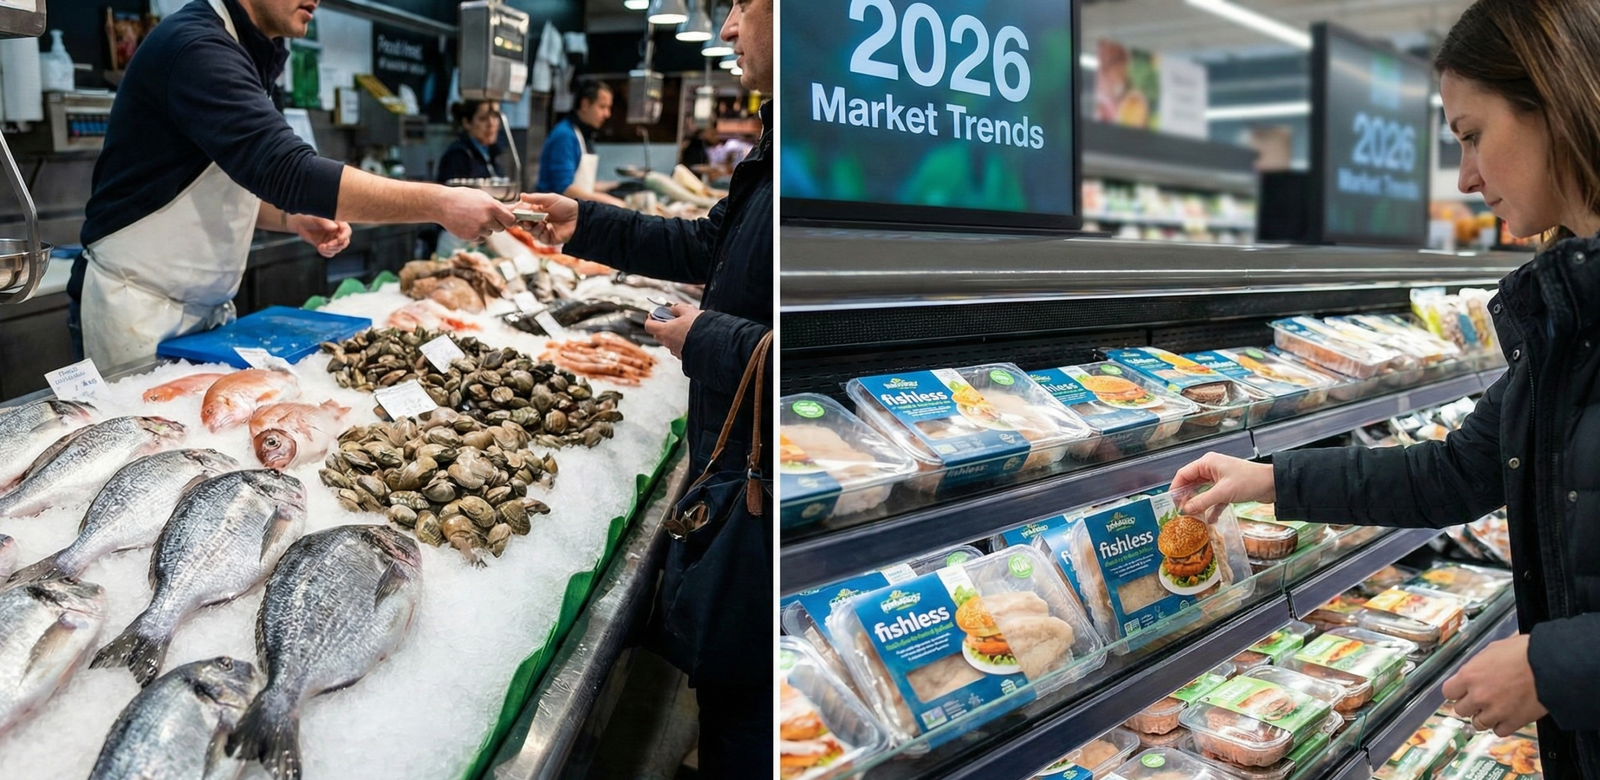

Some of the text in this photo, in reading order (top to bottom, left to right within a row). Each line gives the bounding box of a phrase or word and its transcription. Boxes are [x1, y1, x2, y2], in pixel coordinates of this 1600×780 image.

[848, 0, 1031, 103] 2026
[811, 82, 1044, 150] Market Trends
[1351, 111, 1415, 172] 2026
[880, 391, 948, 406] fishless
[1099, 531, 1154, 559] fishless
[873, 606, 950, 643] fishless
